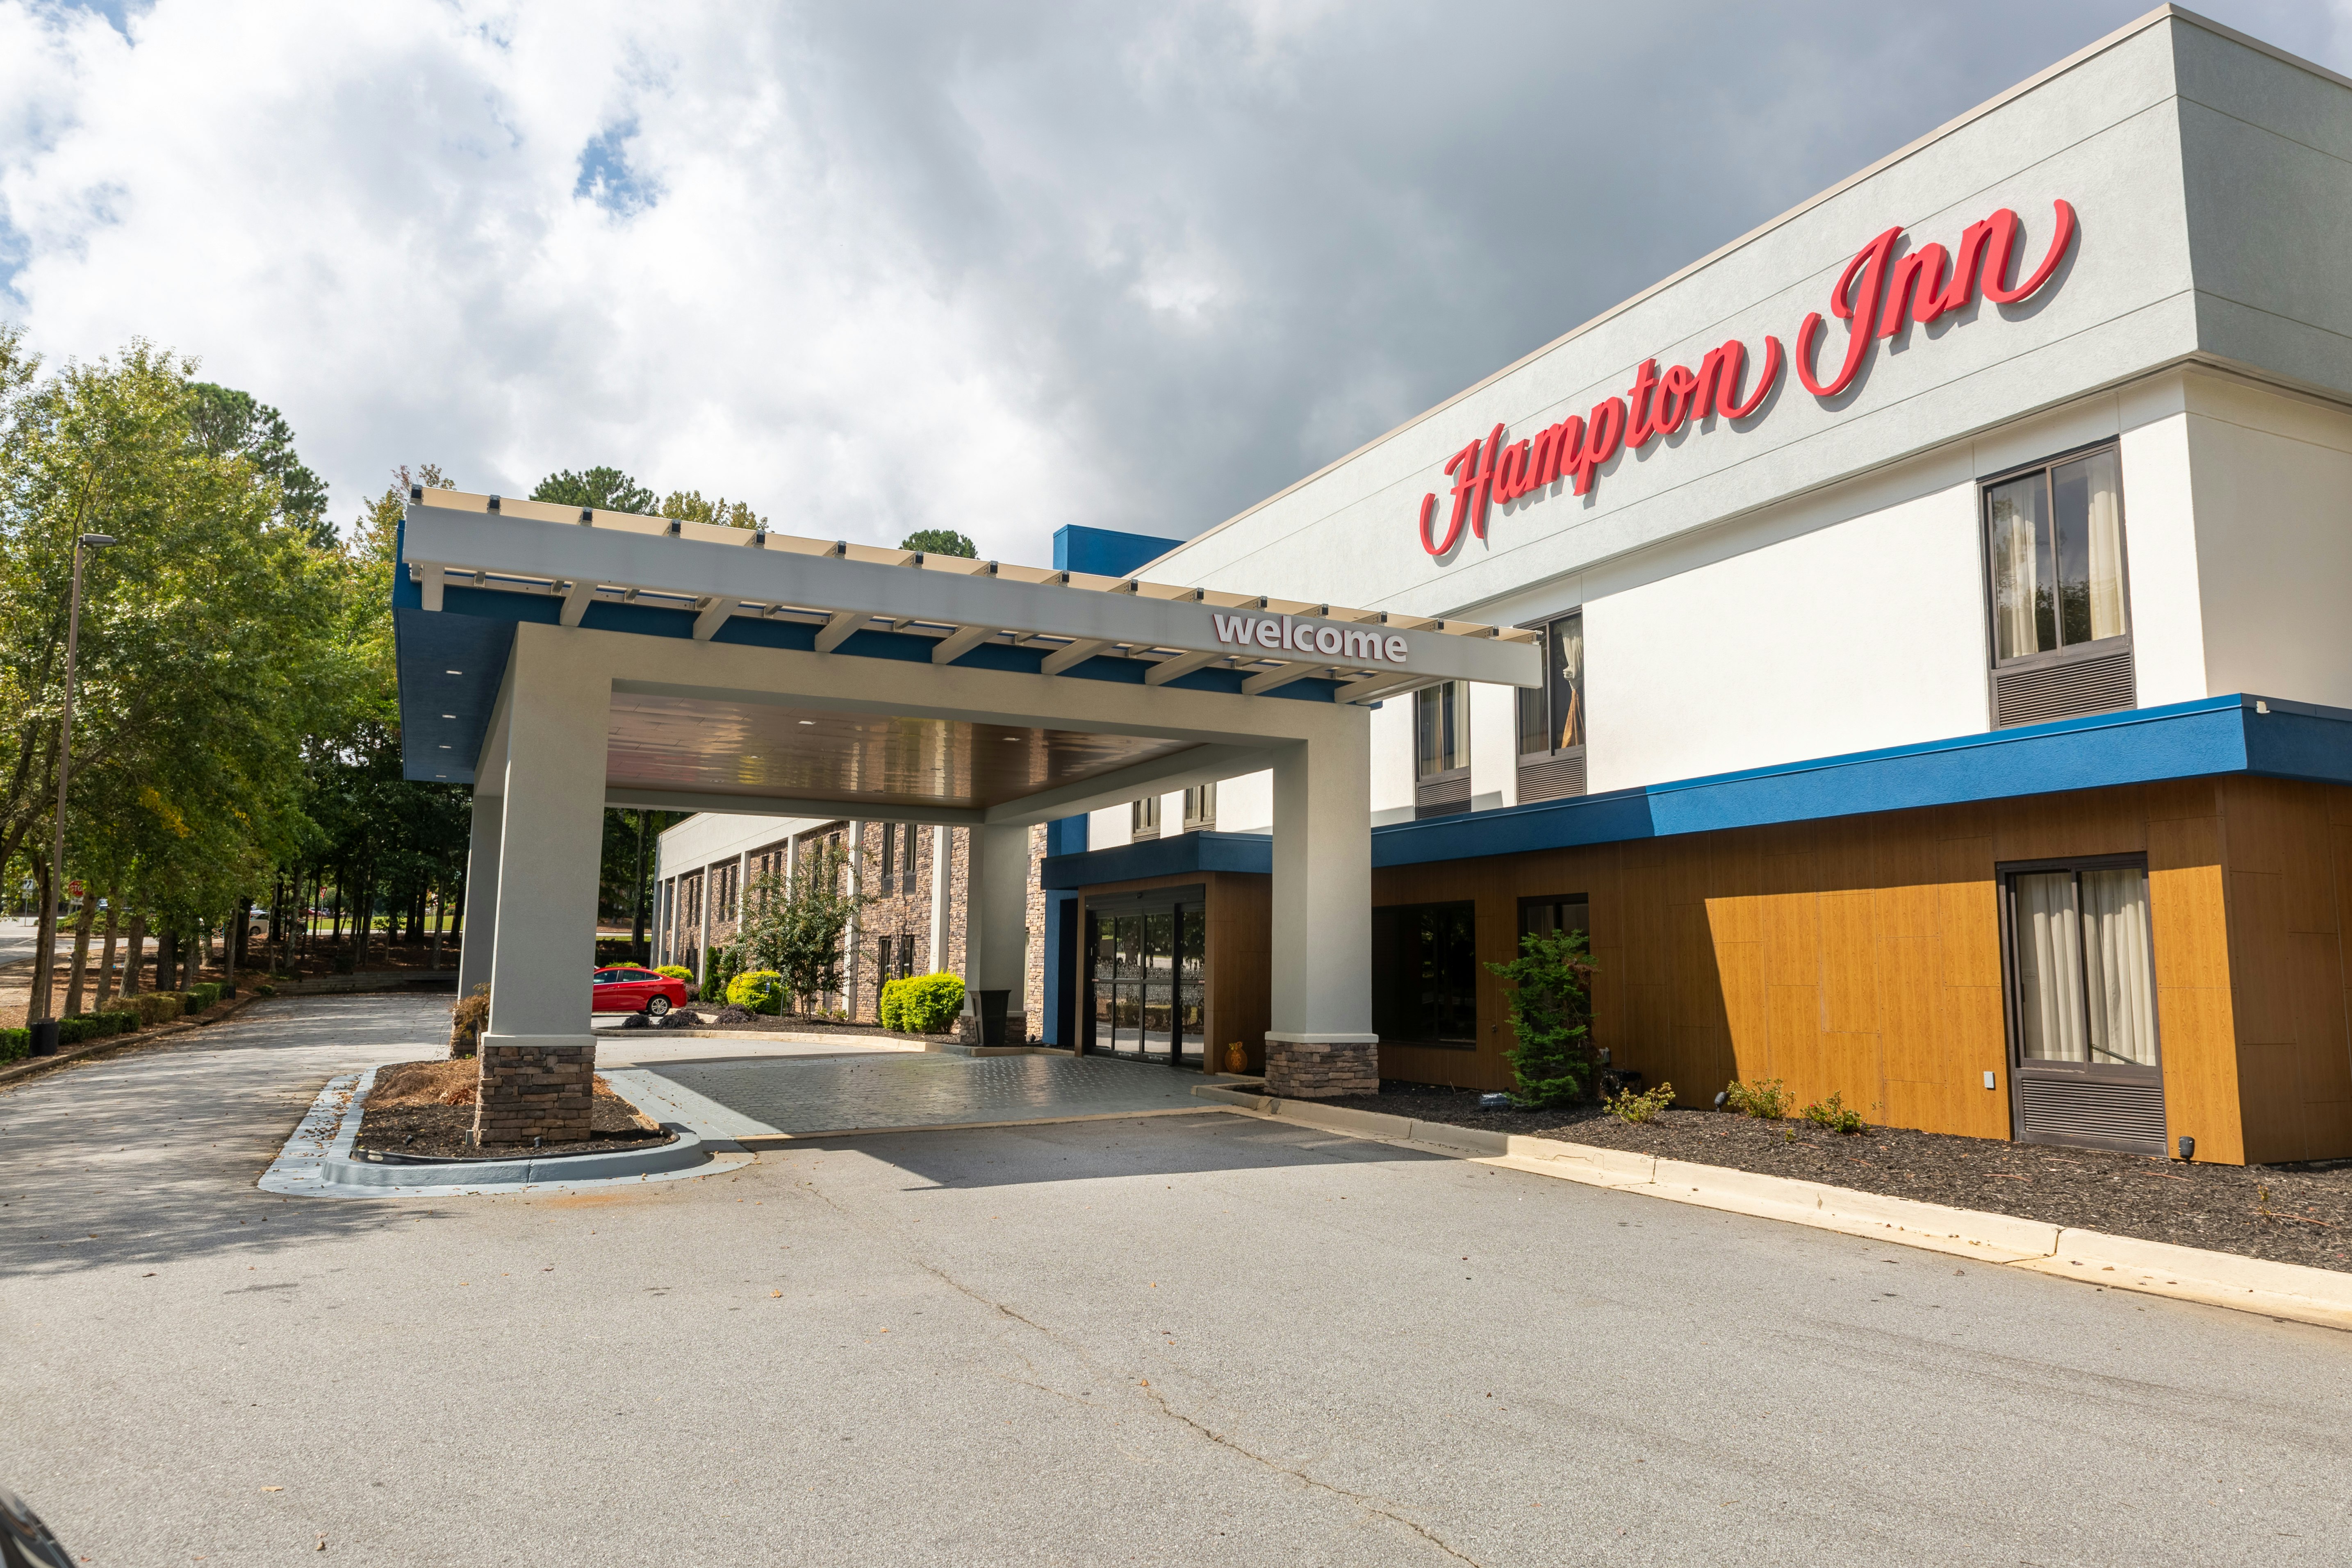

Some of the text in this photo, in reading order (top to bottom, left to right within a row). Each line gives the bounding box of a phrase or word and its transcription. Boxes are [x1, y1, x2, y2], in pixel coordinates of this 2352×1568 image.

[1420, 199, 2075, 555] Hampton Inn
[1212, 614, 1408, 662] welcome
